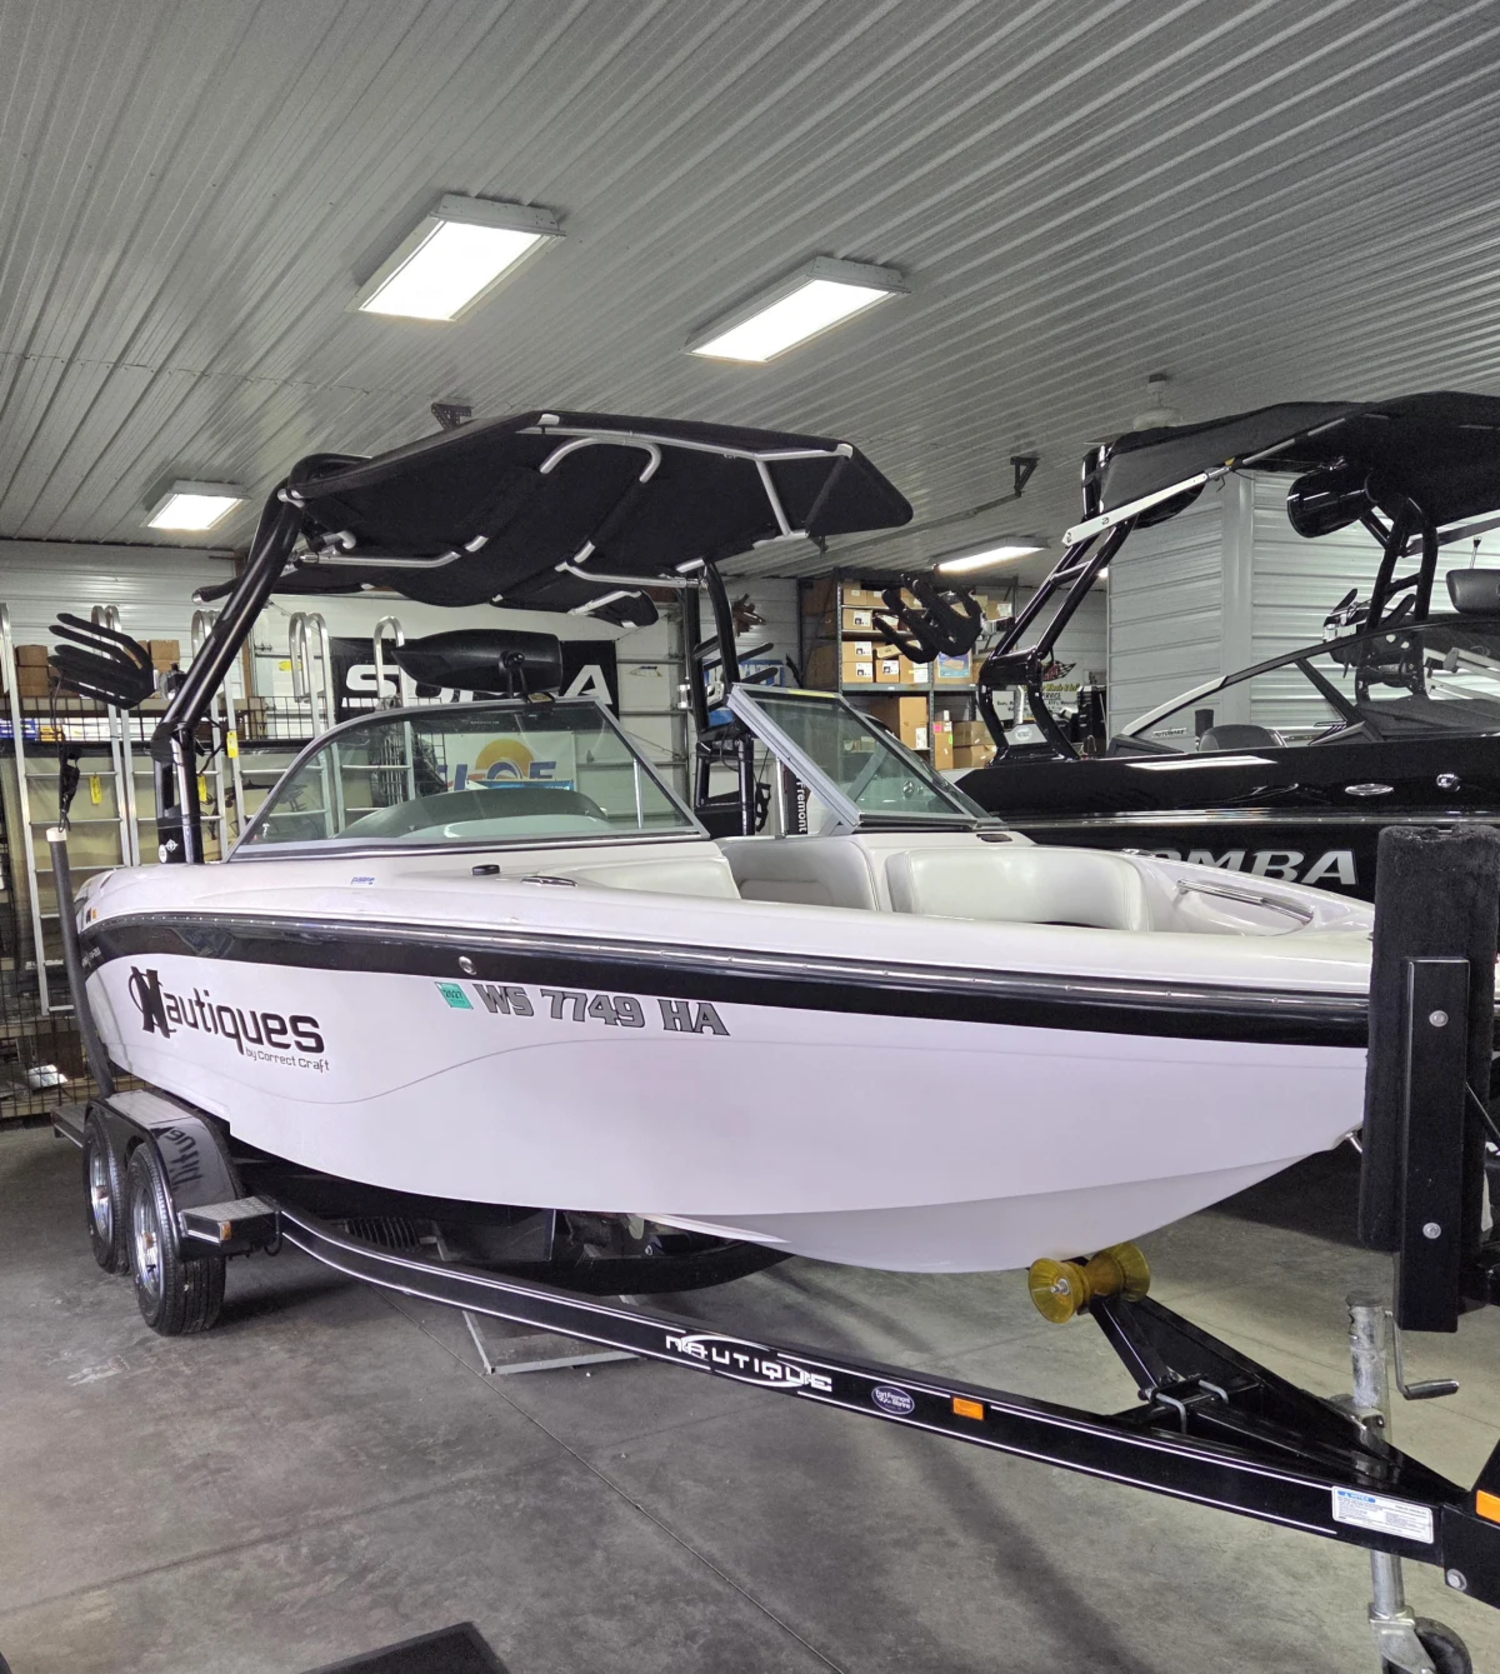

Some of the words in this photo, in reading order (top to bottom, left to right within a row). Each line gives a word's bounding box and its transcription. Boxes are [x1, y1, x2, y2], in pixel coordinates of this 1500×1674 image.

[129, 966, 325, 1055] Nautiques
[473, 984, 534, 1016] WS
[540, 988, 645, 1028] 7749
[656, 998, 730, 1036] HA
[245, 1048, 256, 1061] by
[258, 1050, 296, 1067] Correct
[298, 1058, 330, 1073] Craft
